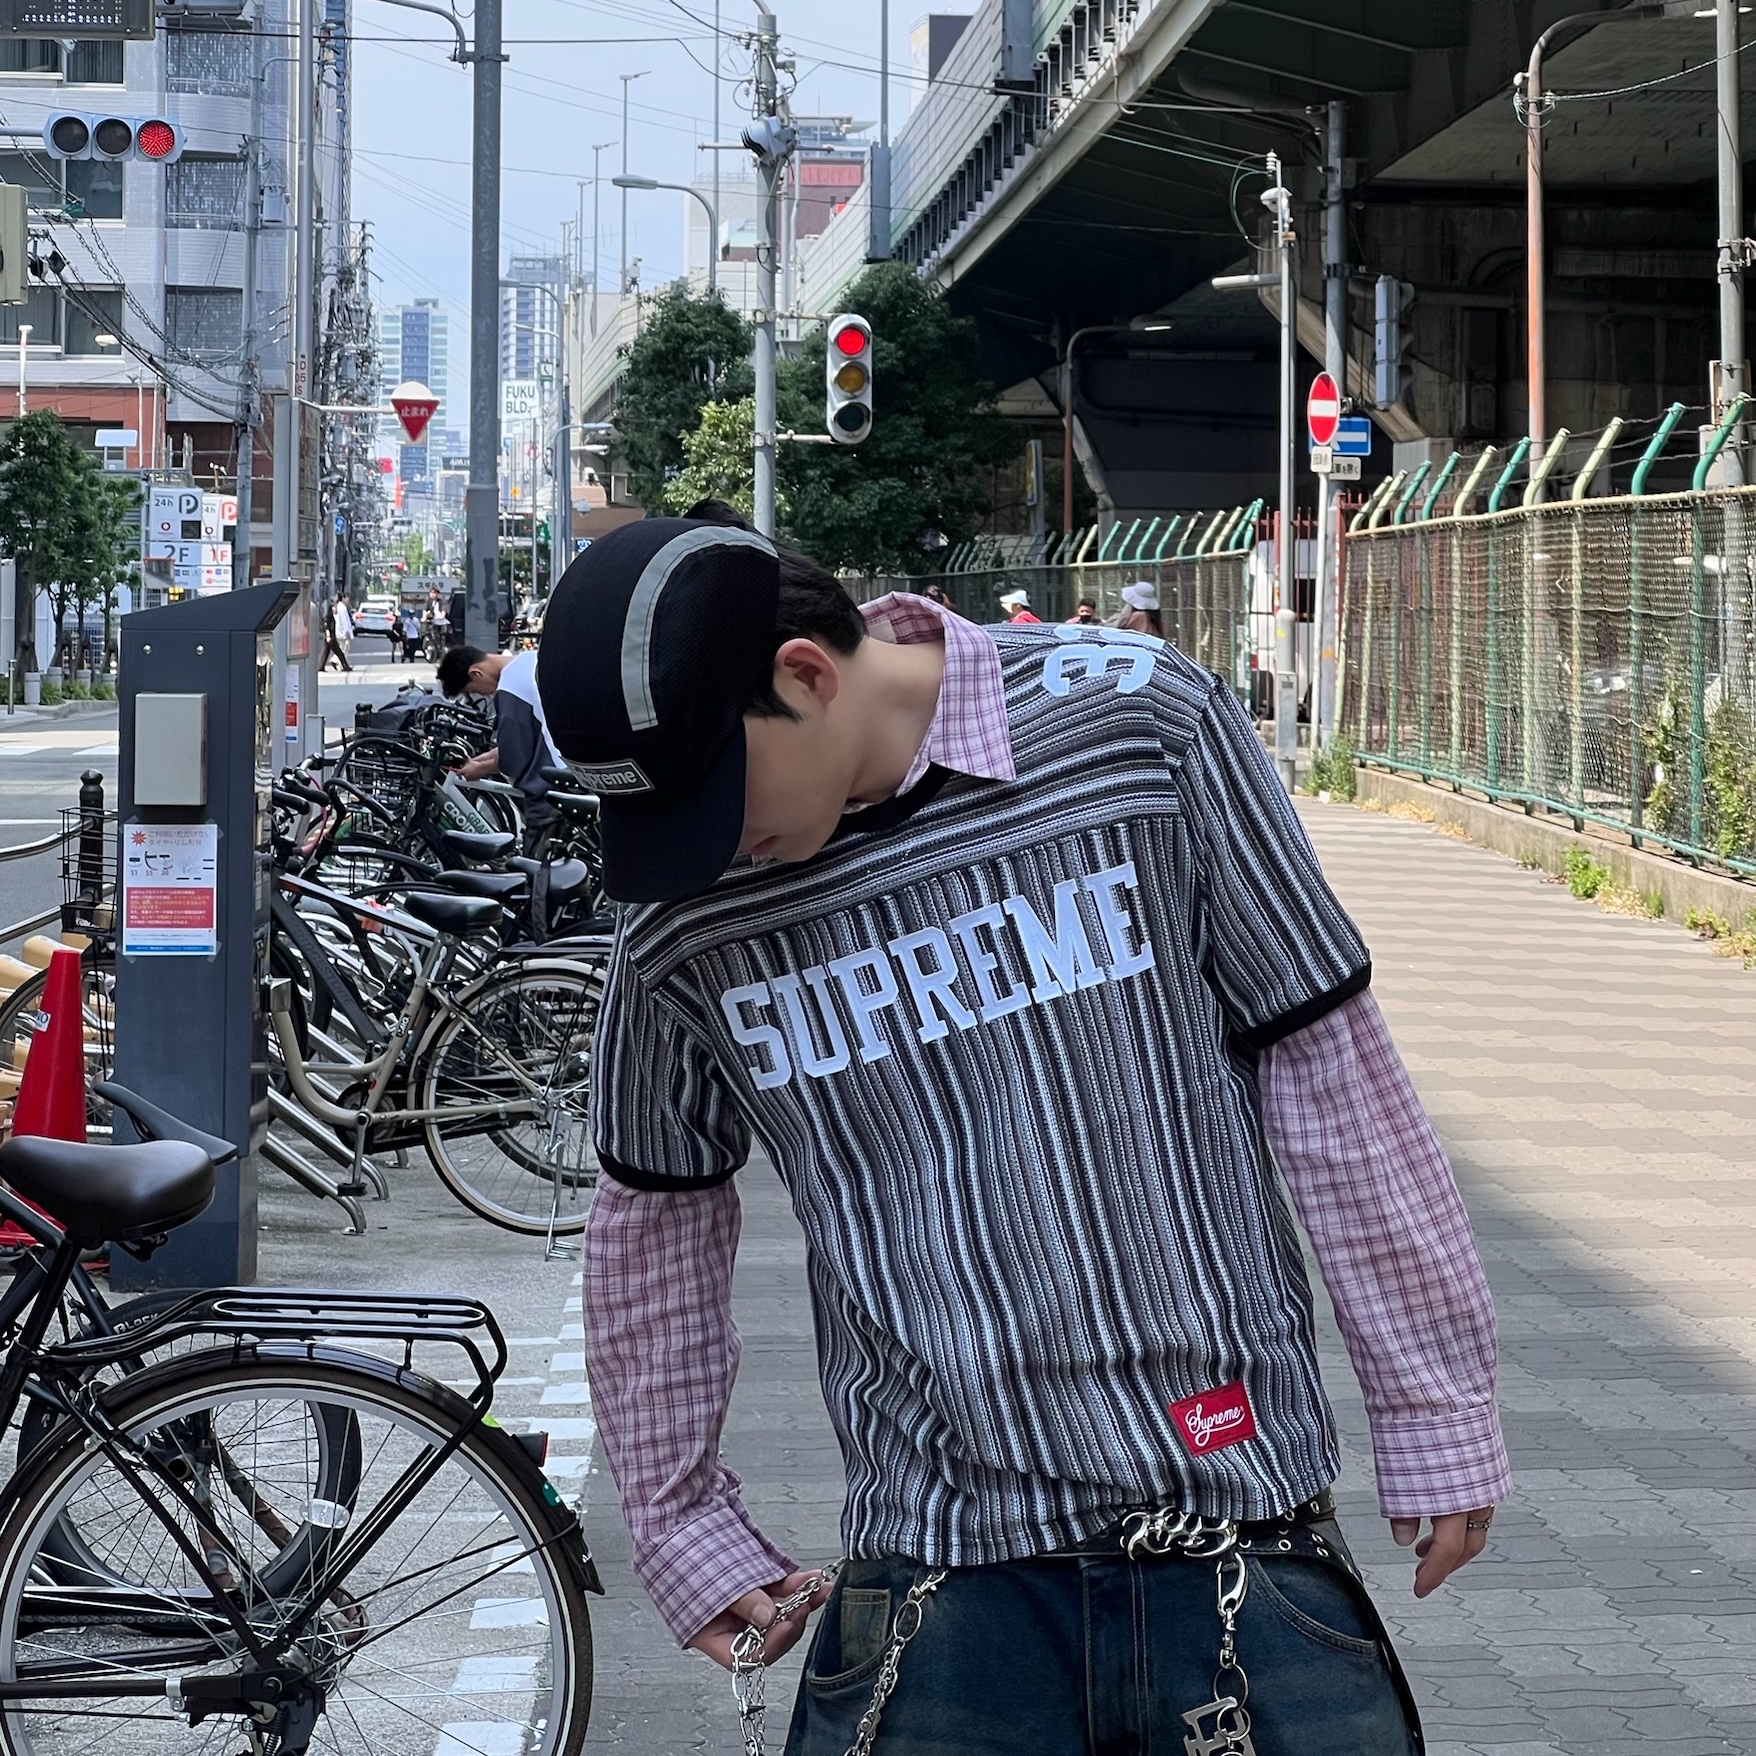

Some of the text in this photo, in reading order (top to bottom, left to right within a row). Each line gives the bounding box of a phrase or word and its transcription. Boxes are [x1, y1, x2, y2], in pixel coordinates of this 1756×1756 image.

[506, 386, 535, 398] FUKU
[401, 406, 429, 417] 止まれ
[506, 402, 530, 413] BLD.
[1331, 463, 1359, 474] 車を除く
[155, 498, 173, 507] 24h
[164, 545, 189, 563] 2F
[720, 861, 1156, 1091] SUPREME
[1185, 1403, 1245, 1447] Supreme
